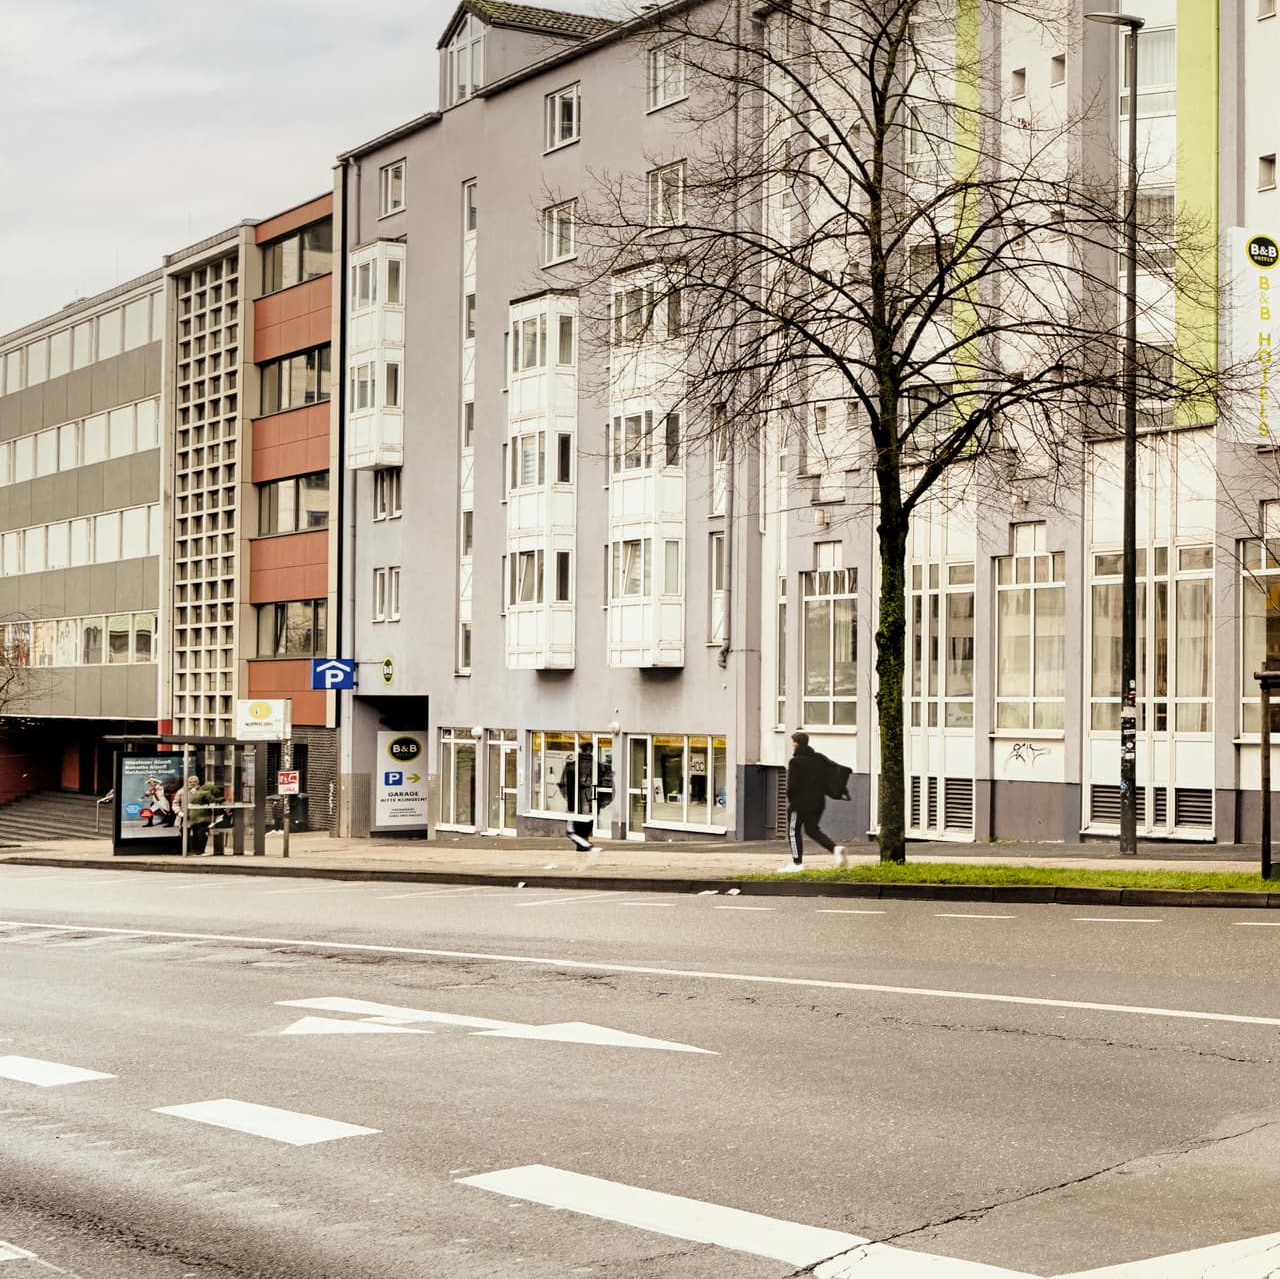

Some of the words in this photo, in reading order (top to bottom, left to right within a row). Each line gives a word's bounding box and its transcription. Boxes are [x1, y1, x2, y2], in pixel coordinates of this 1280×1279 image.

[1251, 243, 1277, 258] B&B
[1258, 332, 1272, 438] HOTELS
[325, 670, 344, 689] P
[392, 744, 418, 753] B&B
[388, 773, 400, 784] P
